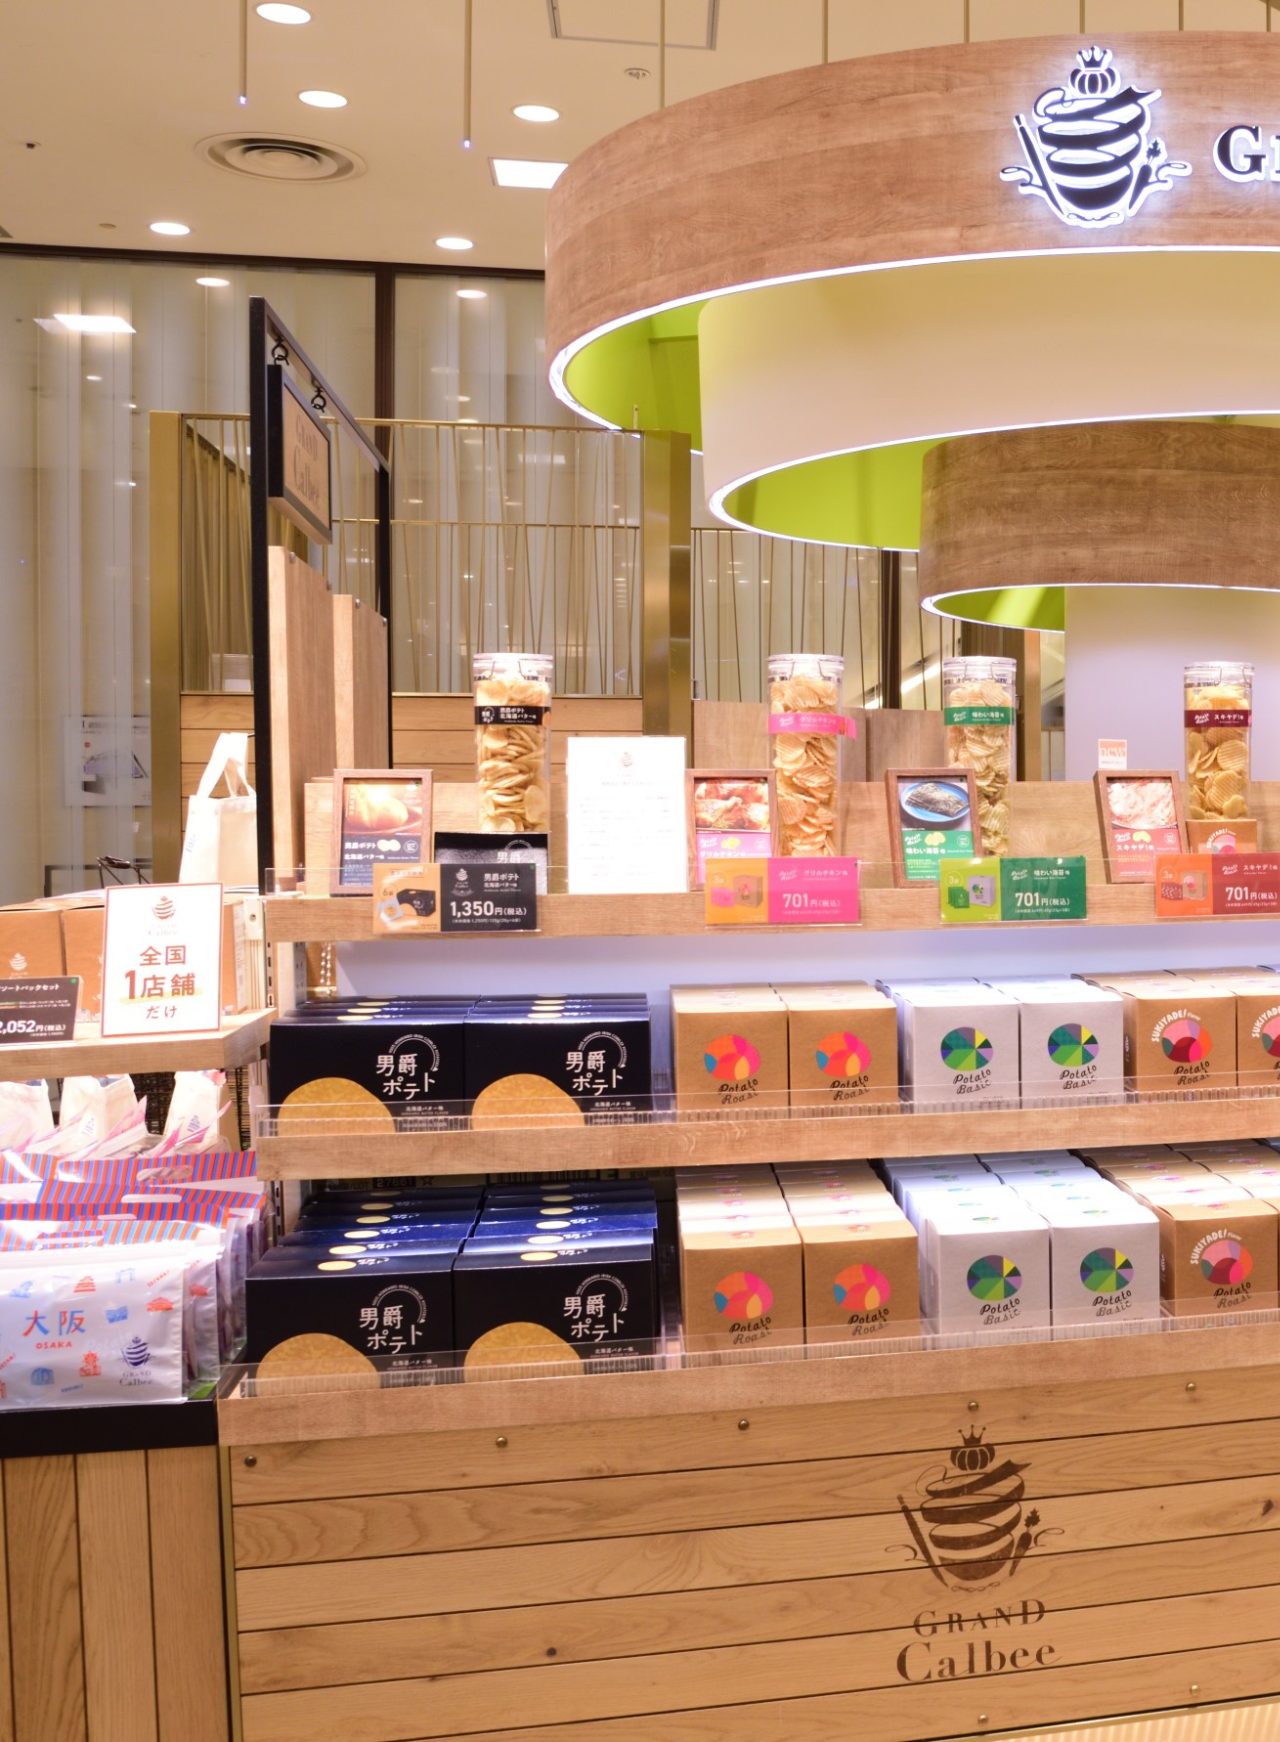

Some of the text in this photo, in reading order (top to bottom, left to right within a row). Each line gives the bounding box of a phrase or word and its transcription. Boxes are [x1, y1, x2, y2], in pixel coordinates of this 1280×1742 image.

[139, 945, 186, 966] 全国
[125, 969, 196, 1000] 1店舗
[146, 1005, 177, 1019] だけ
[376, 1053, 418, 1076] 男爵
[566, 1050, 606, 1072] 男爵
[1173, 1059, 1210, 1075] Potato
[572, 1069, 623, 1096] ポテト
[829, 1074, 868, 1091] Potato
[953, 1068, 992, 1085] Potato
[1060, 1064, 1097, 1080] Potato
[383, 1072, 435, 1100] ポテト
[718, 1077, 758, 1094] Potato
[1093, 1290, 1132, 1308] Potato
[1213, 1281, 1252, 1298] Potato
[564, 1293, 606, 1319] 男爵
[847, 1308, 890, 1325] Potato
[979, 1298, 1020, 1316] Potato
[22, 1310, 86, 1337] 大阪
[360, 1305, 403, 1330] 男爵
[571, 1313, 624, 1342] ポテト
[729, 1316, 772, 1333] Potato
[36, 1341, 72, 1349] OSAKA
[367, 1324, 422, 1354] ポテト
[913, 1599, 1045, 1637] GRAND
[897, 1641, 1062, 1681] Calbee
